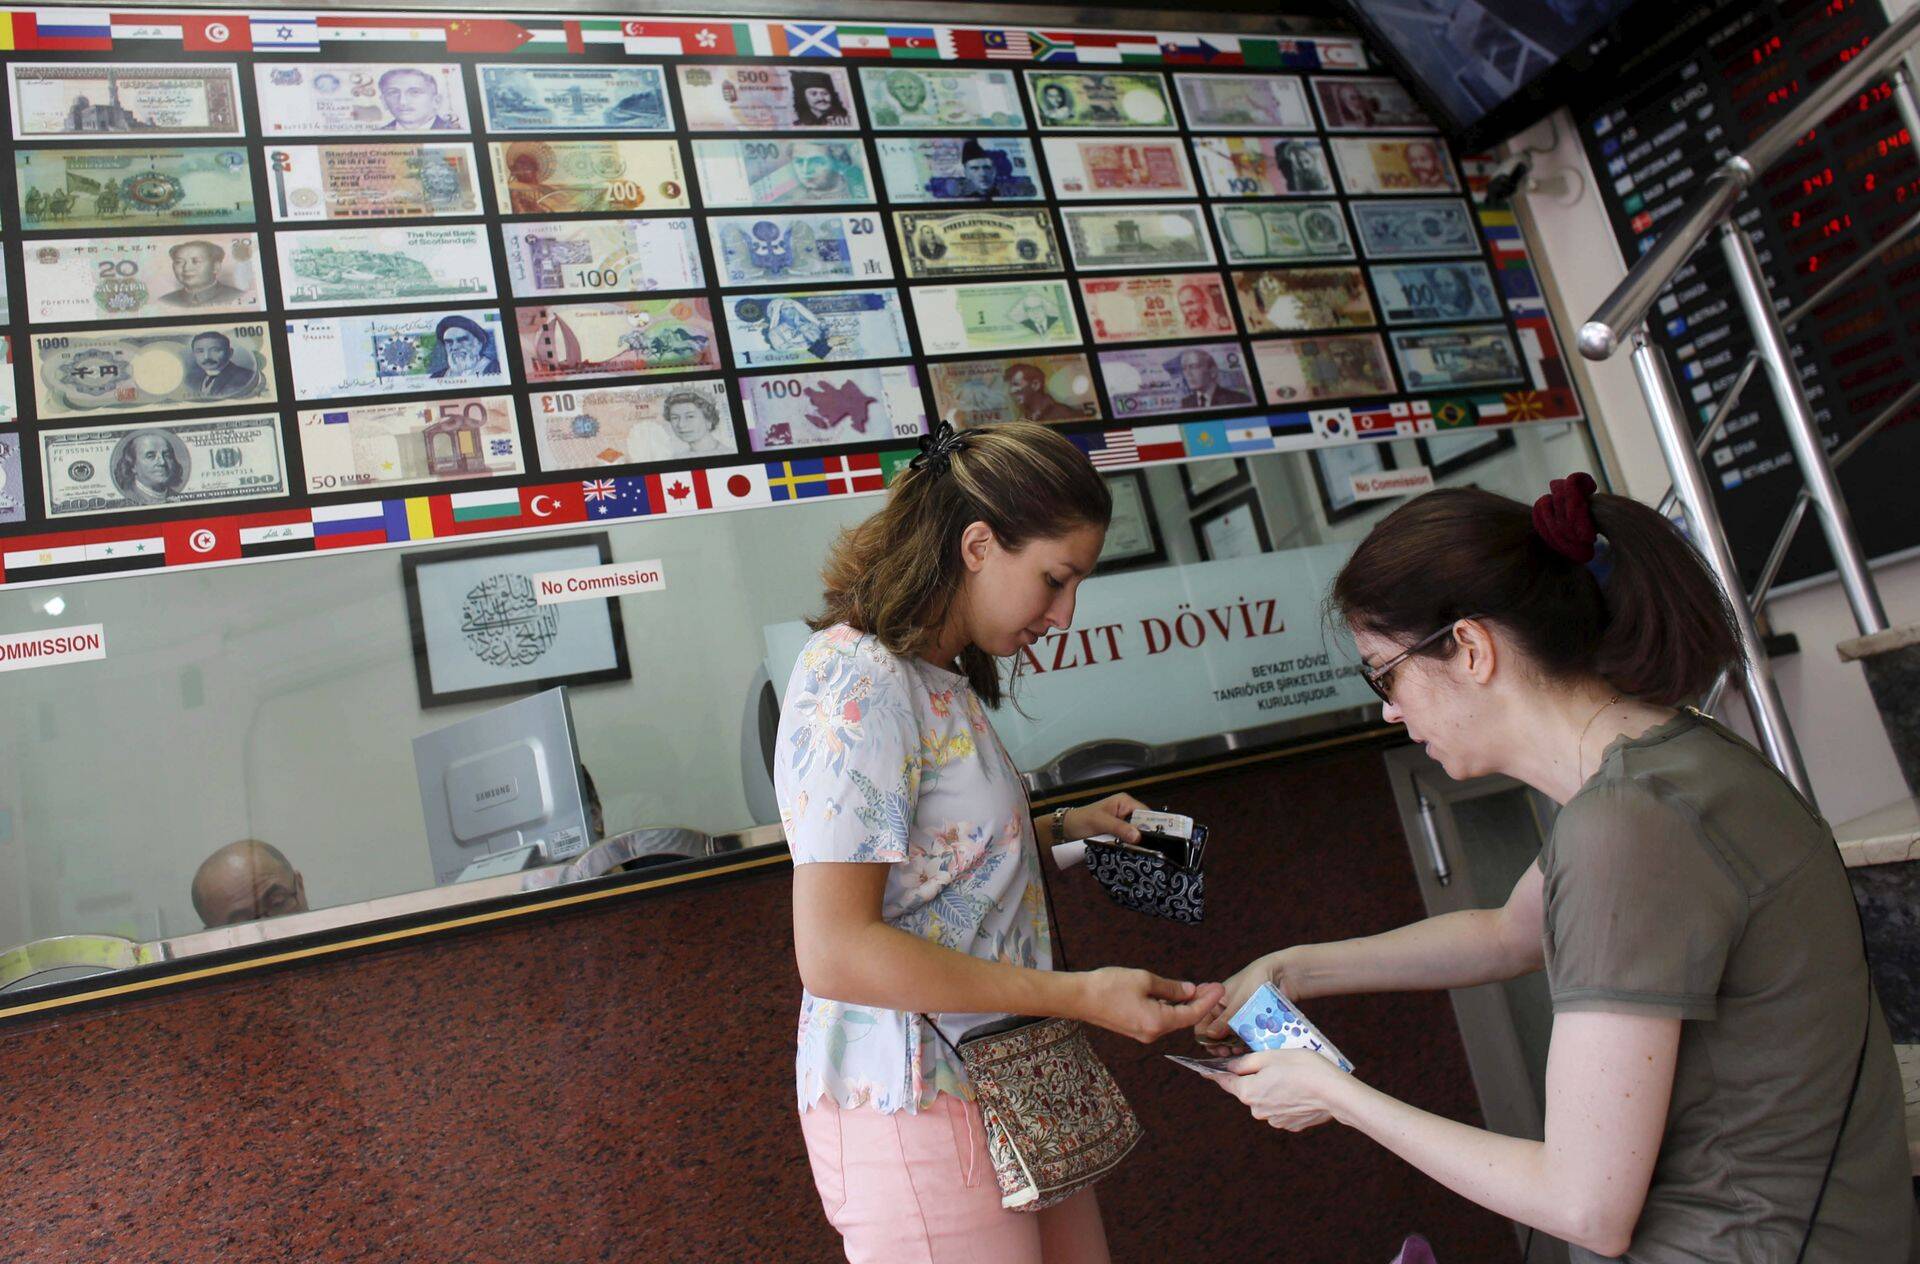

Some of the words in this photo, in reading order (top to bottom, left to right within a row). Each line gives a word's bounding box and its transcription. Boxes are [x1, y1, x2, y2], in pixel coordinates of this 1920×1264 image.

[737, 70, 768, 83] 500
[606, 182, 638, 201] 200
[668, 221, 687, 230] 100
[849, 218, 874, 234] 20
[406, 231, 423, 239] The
[426, 230, 450, 240] Royal
[453, 230, 476, 238] Bank
[418, 237, 461, 245] Scotland
[462, 236, 477, 246] plc
[99, 260, 138, 278] 20
[732, 270, 745, 280] 20
[576, 269, 618, 287] 100
[234, 326, 263, 338] 1000
[37, 337, 69, 350] 1000
[742, 351, 753, 364] 1
[713, 383, 725, 394] 10
[761, 379, 802, 399] 100
[541, 393, 575, 414] £10
[1083, 402, 1097, 417] 5
[895, 423, 919, 435] 100
[239, 474, 275, 485] 100
[312, 474, 336, 489] 50
[340, 473, 371, 482] EURO
[1355, 480, 1370, 492] No
[1371, 474, 1430, 491] Commission
[541, 579, 563, 596] No
[567, 569, 659, 592] Commission
[1139, 595, 1286, 656] DÖVİZ
[1251, 660, 1294, 678] BEYAZIT
[1214, 681, 1275, 702] TANRIÖVER
[1276, 670, 1334, 692] ŞİRKETLER
[476, 784, 511, 802] SAMSUNG
